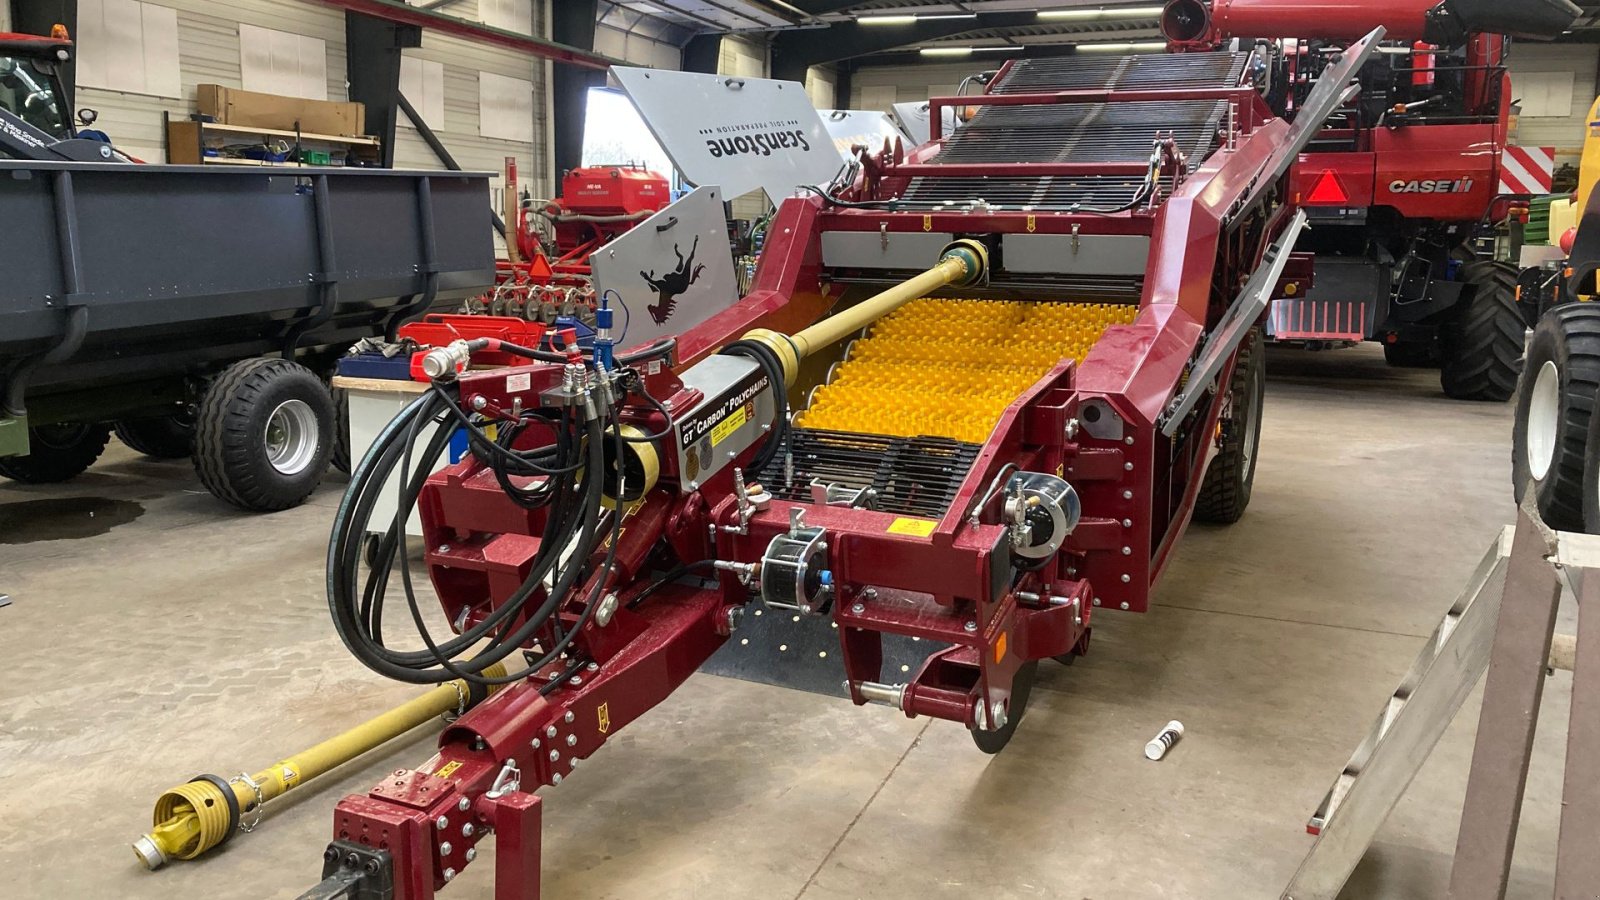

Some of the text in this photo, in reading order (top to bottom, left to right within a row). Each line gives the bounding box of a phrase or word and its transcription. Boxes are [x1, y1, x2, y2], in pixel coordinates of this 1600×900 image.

[715, 120, 786, 133] SOIL PREPARATION
[706, 130, 810, 158] ScanStone
[1389, 179, 1452, 193] CASE
